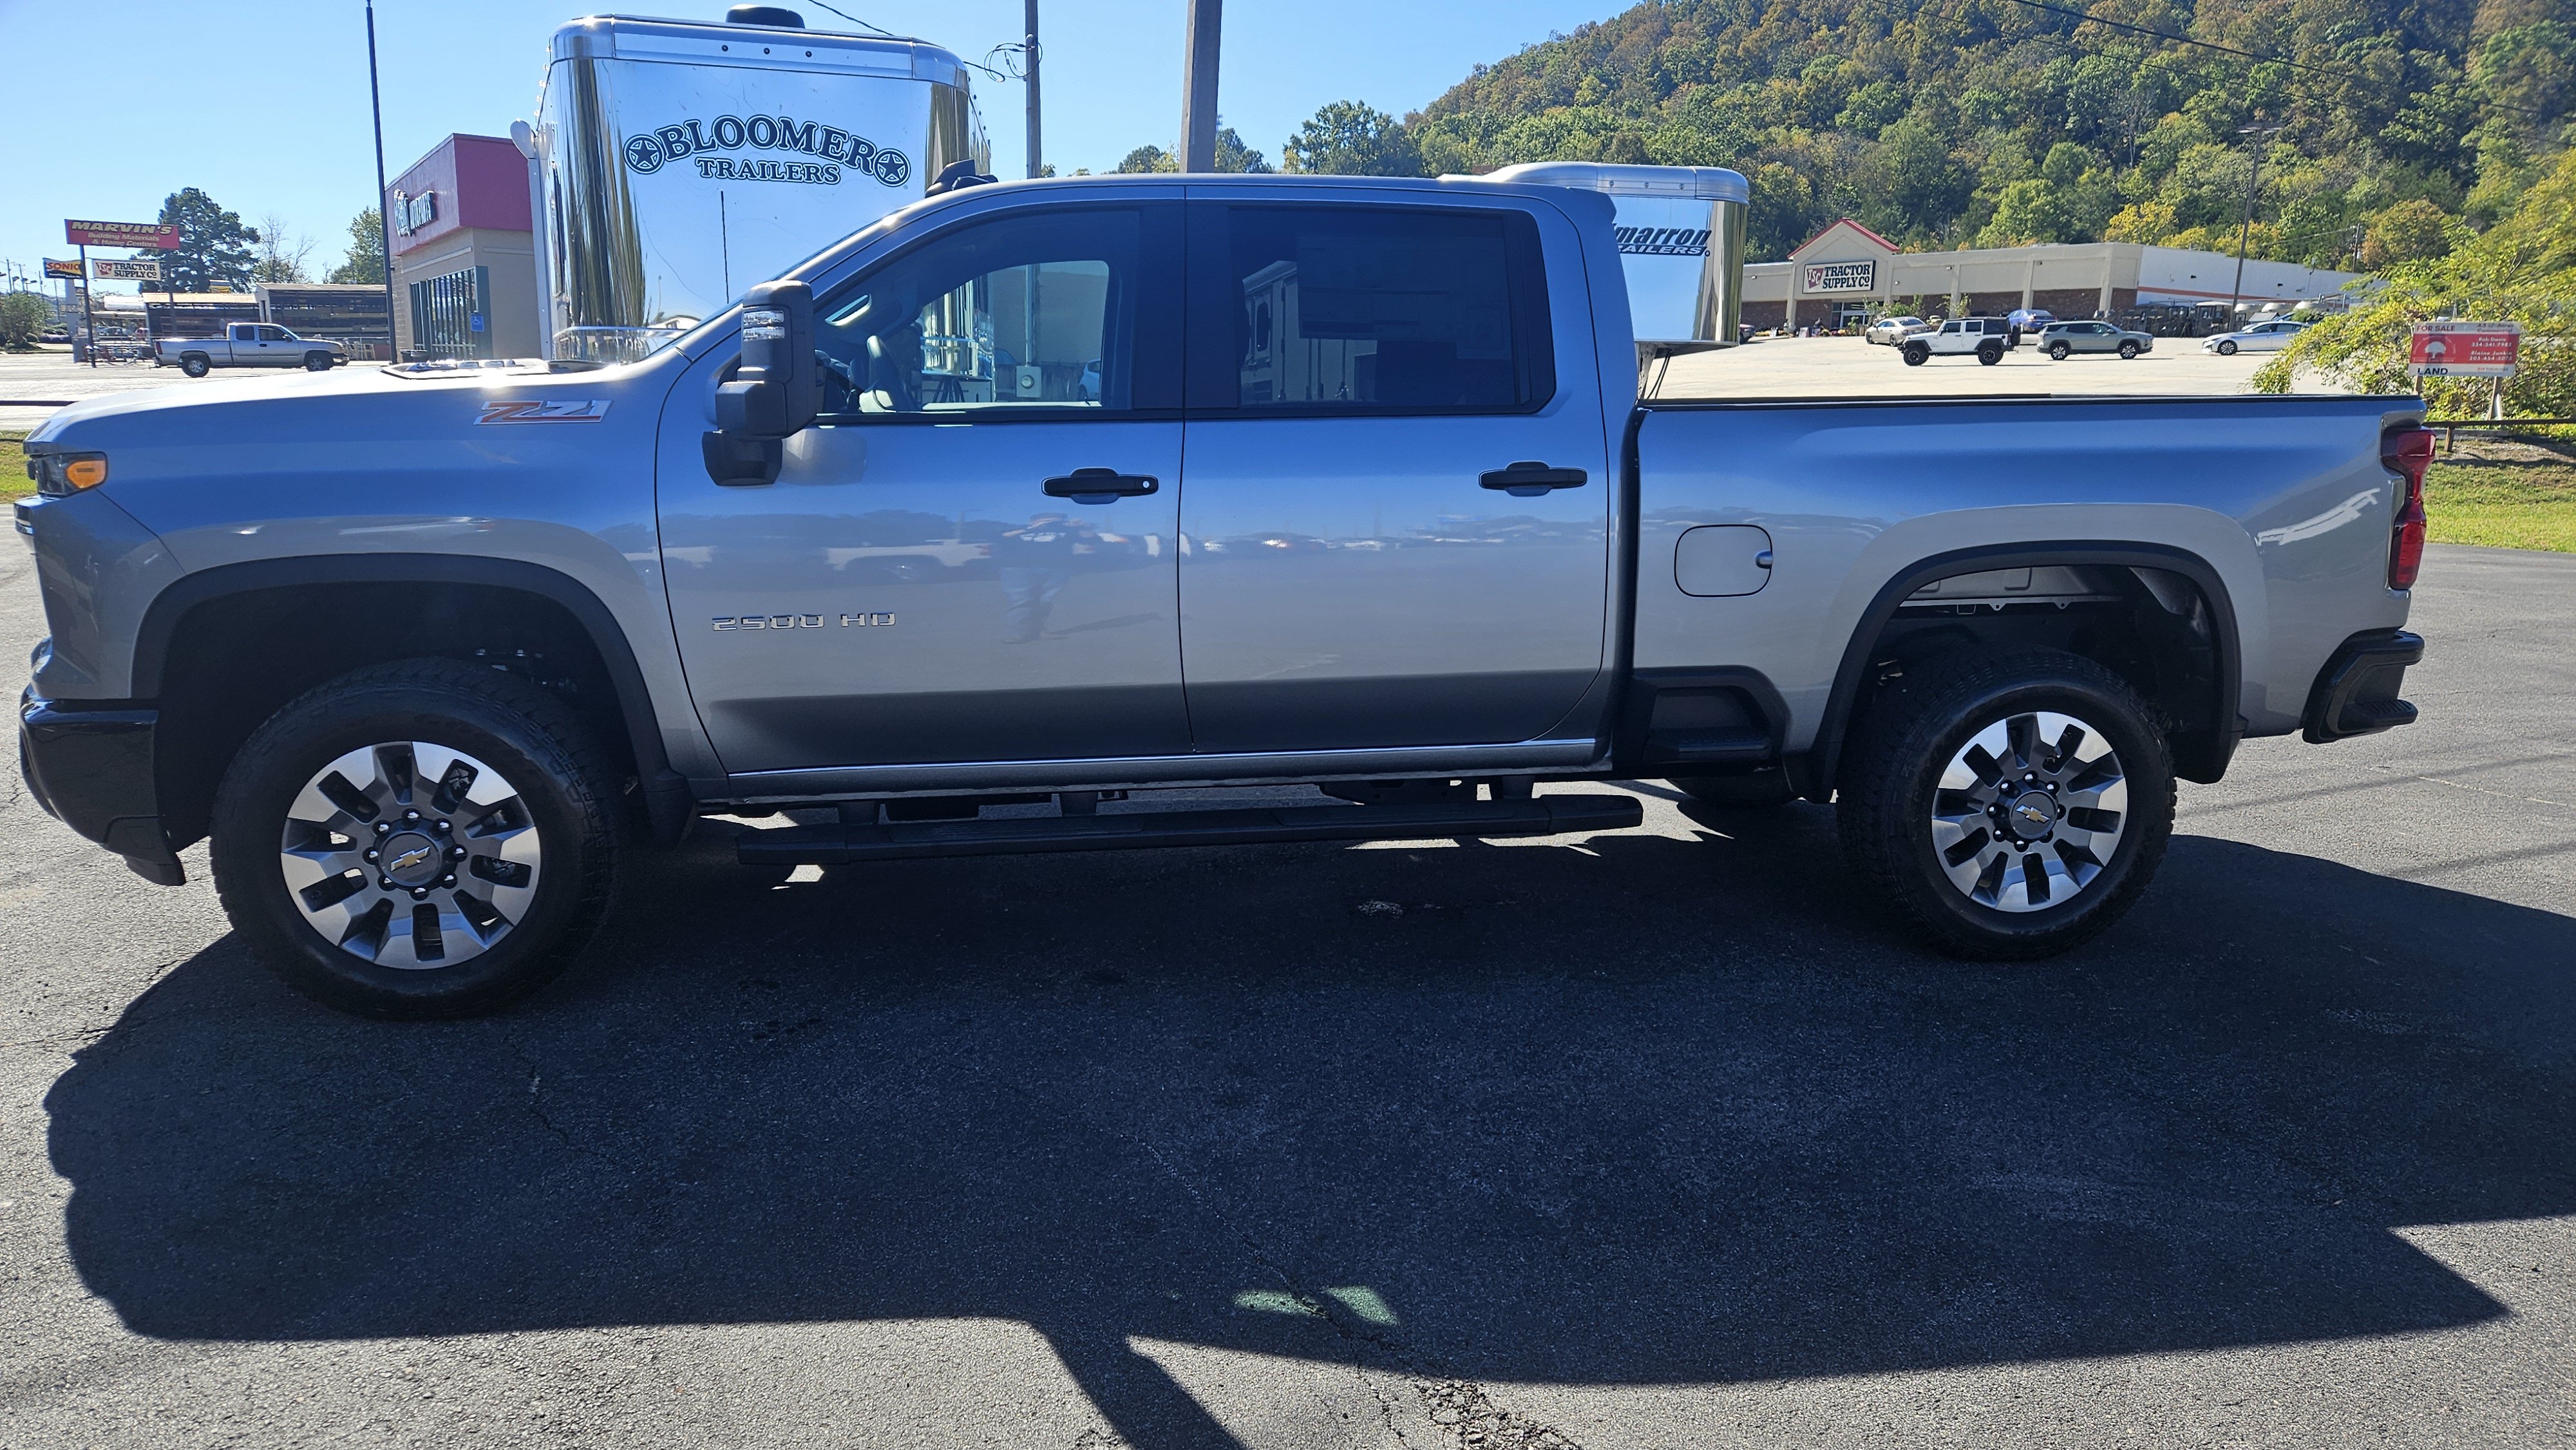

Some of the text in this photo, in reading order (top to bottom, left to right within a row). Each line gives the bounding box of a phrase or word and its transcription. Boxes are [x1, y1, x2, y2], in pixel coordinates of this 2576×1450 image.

[655, 114, 877, 175] BLOOMER
[695, 156, 841, 185] TRAILERS
[71, 221, 173, 234] MARVIN'S
[88, 232, 119, 241] Building
[1613, 223, 1712, 246] marron
[1618, 245, 1701, 254] AILERS
[46, 262, 79, 270] SONIC
[97, 262, 111, 274] TSC
[113, 262, 156, 271] TRACTOR
[1824, 264, 1871, 277] TRACTOR
[1808, 268, 1821, 285] TSC
[1823, 276, 1859, 289] SUPPLY
[473, 400, 614, 426] Z71
[712, 612, 896, 631] 2500 HD
